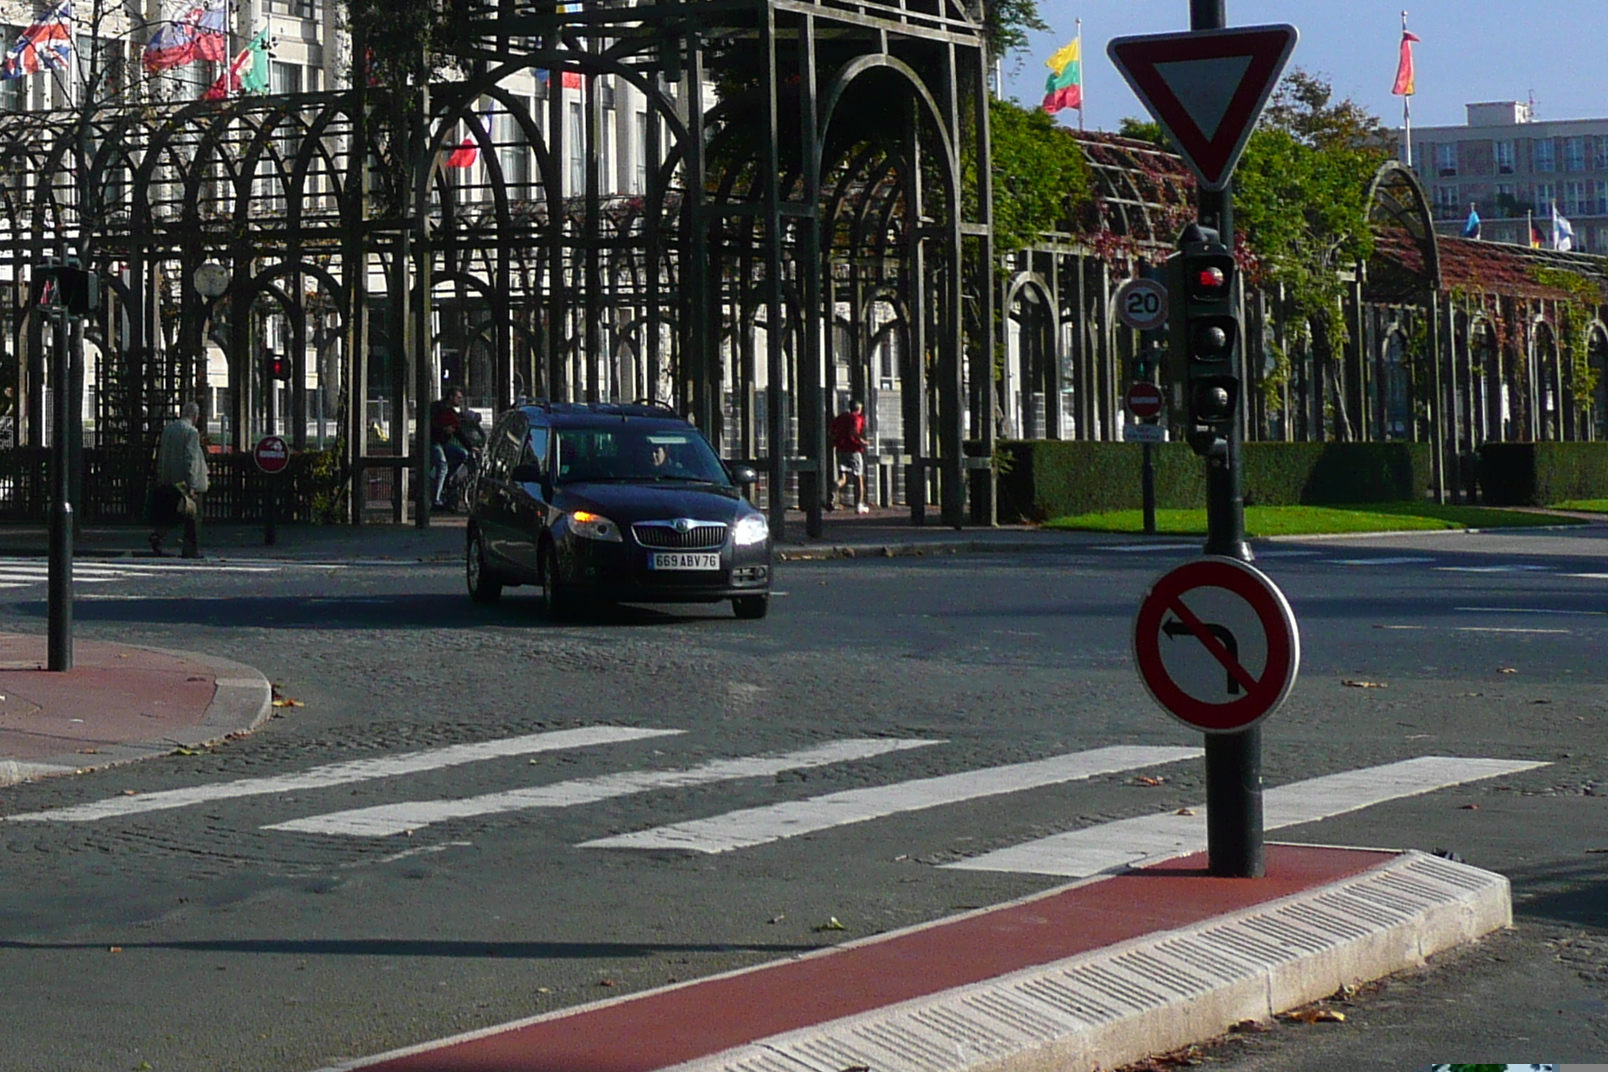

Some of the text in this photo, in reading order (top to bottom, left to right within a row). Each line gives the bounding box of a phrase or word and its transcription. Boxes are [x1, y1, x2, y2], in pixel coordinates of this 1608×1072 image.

[1128, 292, 1160, 314] 20
[656, 555, 716, 567] 669 ABV 76
